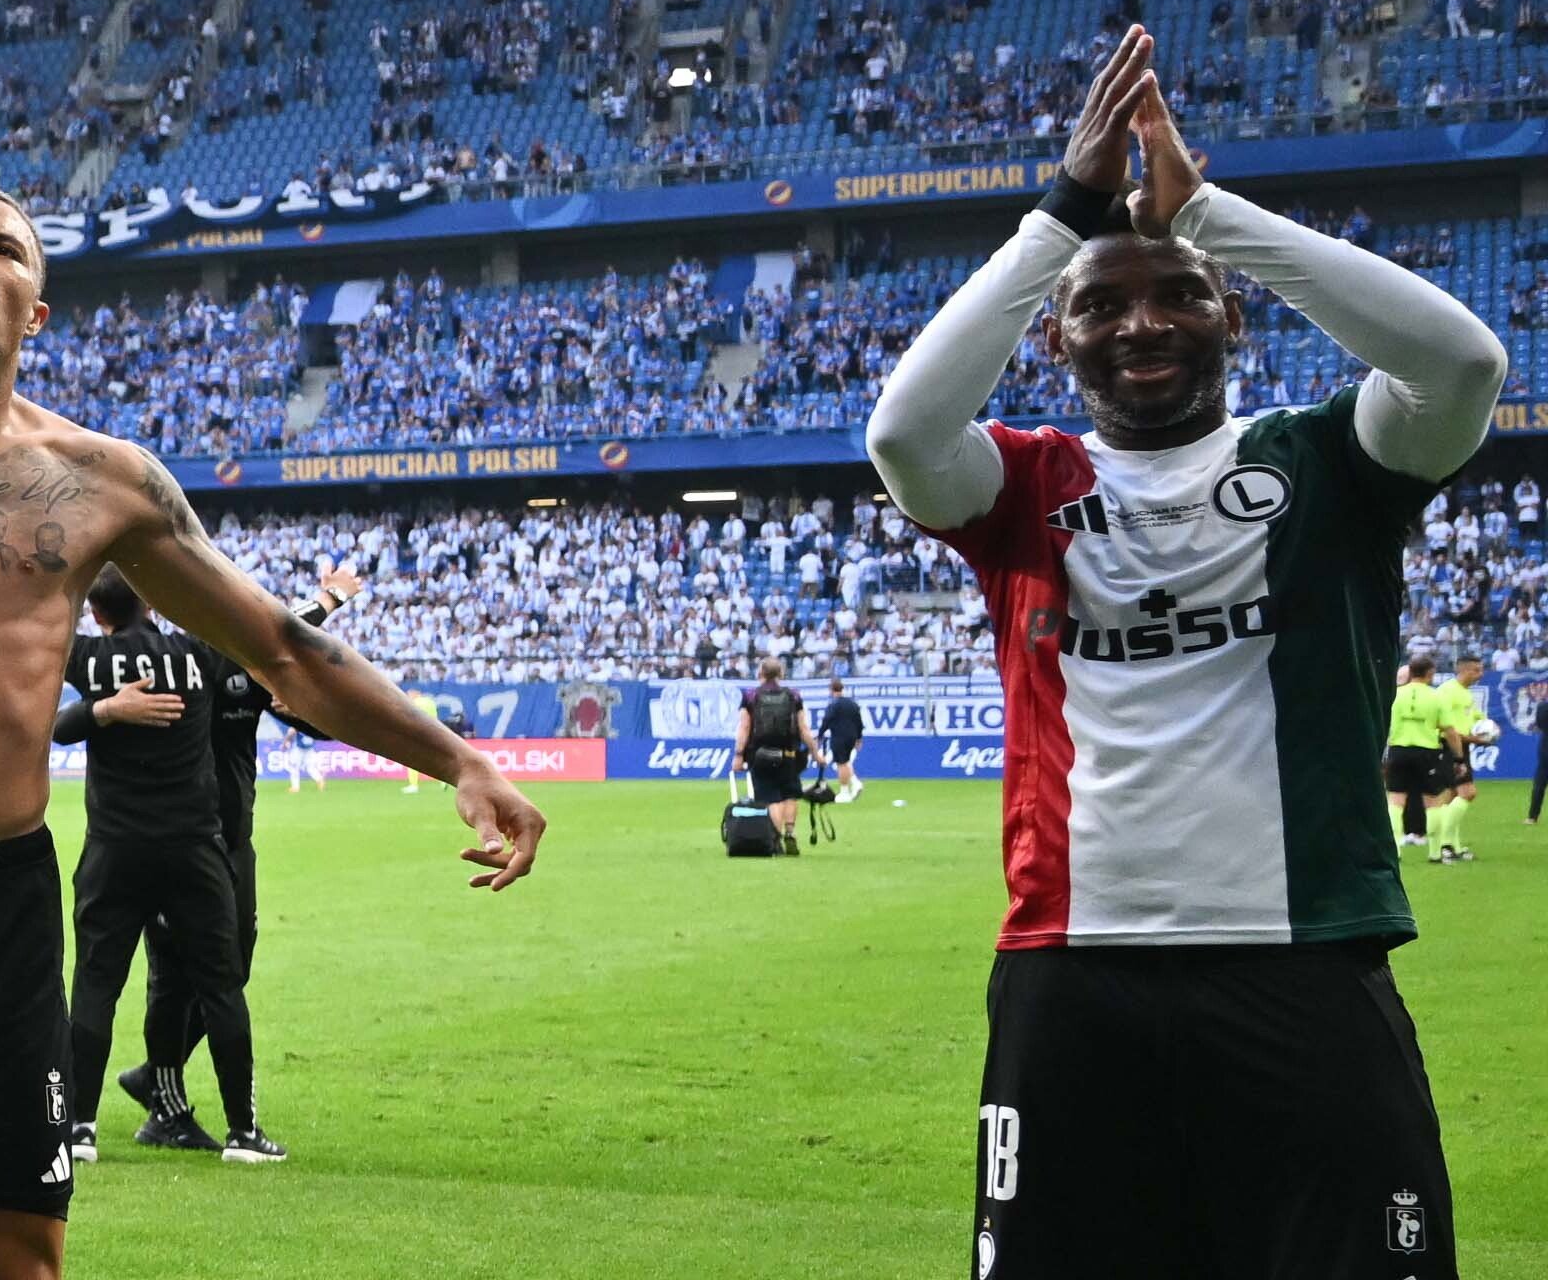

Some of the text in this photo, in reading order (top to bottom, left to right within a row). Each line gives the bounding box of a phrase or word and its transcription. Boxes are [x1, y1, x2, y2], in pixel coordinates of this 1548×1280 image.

[835, 163, 1026, 201] SUPERPUCHAR
[1496, 404, 1548, 431] OLS
[281, 447, 557, 481] SUPERPUCHAR POLSKI
[20, 467, 82, 513] Up
[1231, 480, 1275, 513] L
[1027, 595, 1276, 662] Plus50
[87, 653, 204, 692] LEGIA
[946, 705, 1004, 730] HO
[648, 739, 731, 779] Łączy
[941, 739, 1004, 776] Łącz
[979, 1104, 1020, 1201] 18
